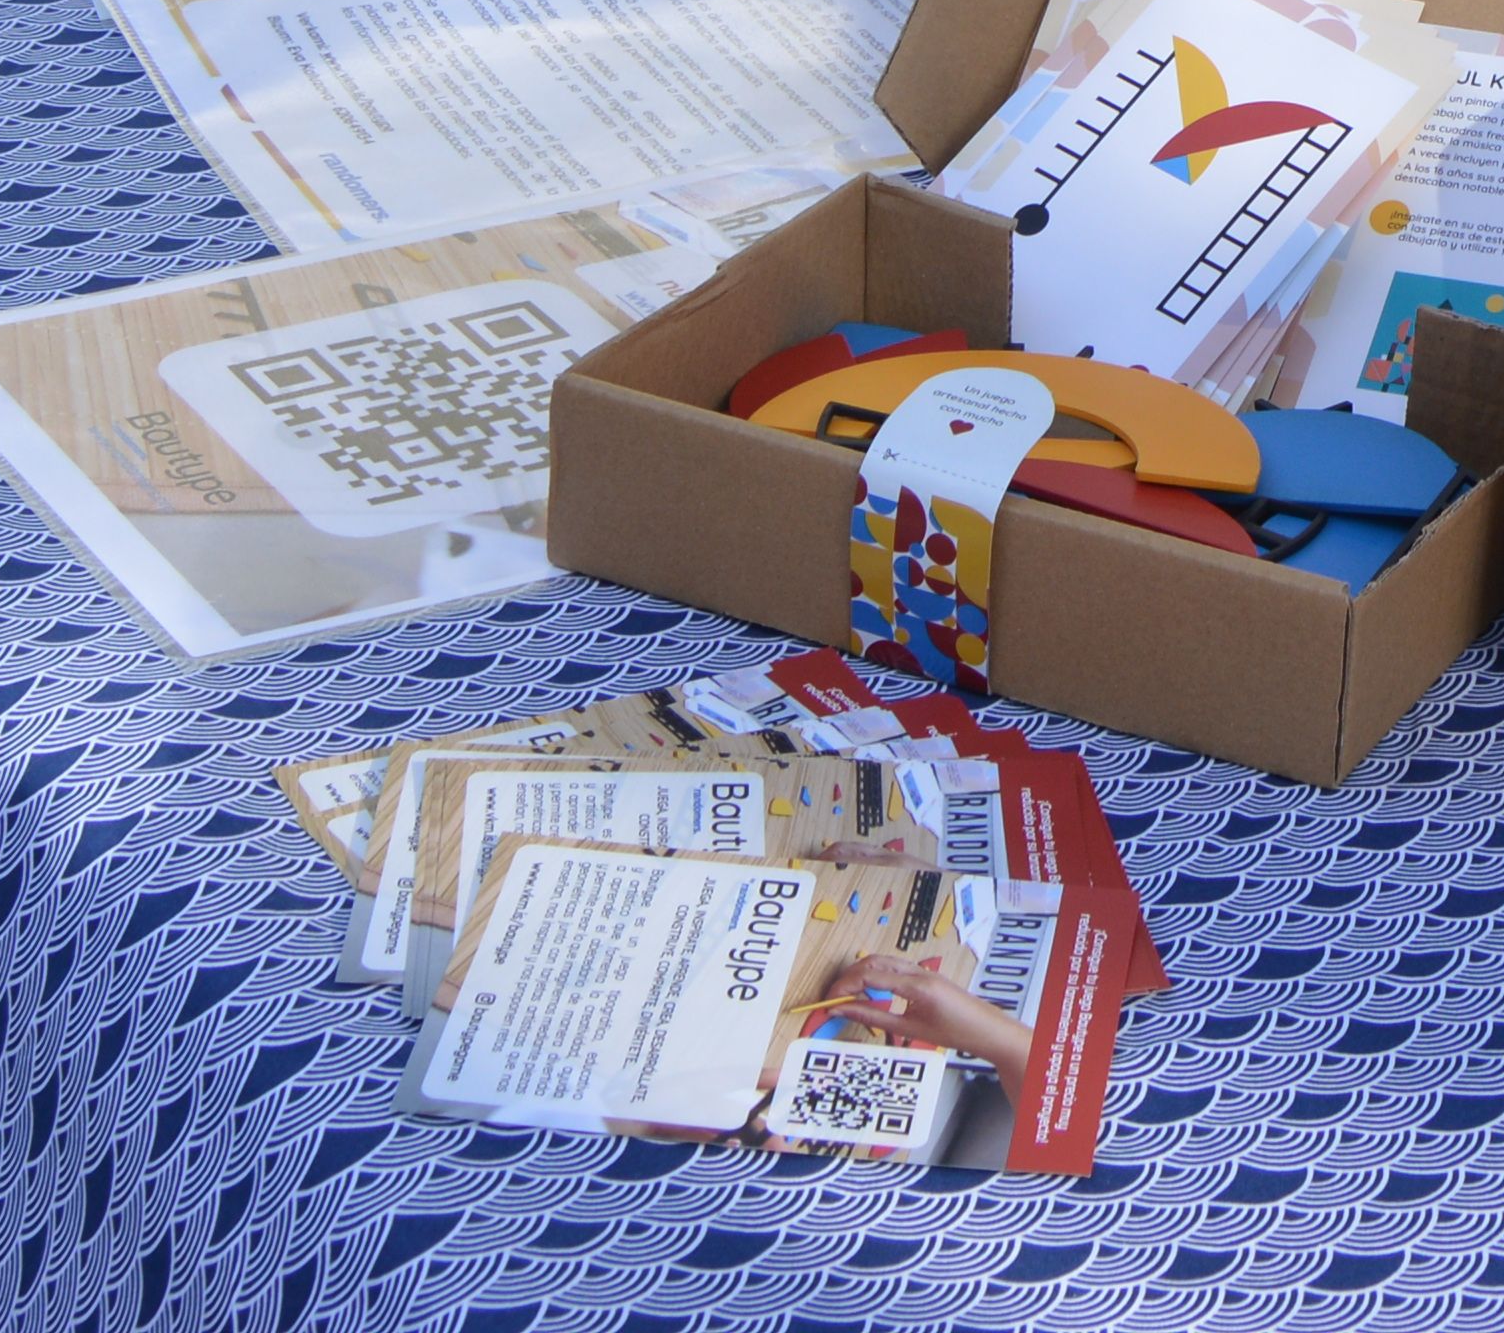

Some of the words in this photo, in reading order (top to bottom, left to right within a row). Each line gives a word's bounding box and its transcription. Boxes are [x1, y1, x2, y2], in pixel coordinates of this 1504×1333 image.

[1449, 95, 1462, 104] un
[1465, 96, 1498, 109] pintor
[1467, 113, 1498, 124] como
[1439, 125, 1483, 138] cuadros
[1449, 136, 1460, 147] la
[1462, 138, 1501, 153] música
[1420, 150, 1451, 161] veces
[1453, 150, 1499, 168] incluyen
[1395, 173, 1460, 190] destacaban
[1414, 164, 1430, 174] los
[1434, 166, 1443, 175] 16
[1447, 166, 1474, 180] años
[1476, 172, 1495, 182] sus
[319, 152, 390, 223] randomers.
[1387, 220, 1407, 231] con
[1411, 223, 1426, 233] las
[1429, 226, 1465, 240] piezas
[1468, 231, 1482, 241] de
[1444, 218, 1458, 227] en
[1462, 219, 1474, 230] su
[1477, 220, 1503, 235] obra
[1398, 233, 1447, 249] dibujarla
[1450, 242, 1458, 251] y
[1460, 242, 1497, 256] utilizar
[933, 389, 990, 410] artesanal
[991, 405, 1027, 421] hecho
[964, 385, 980, 395] Un
[981, 390, 1016, 405] juego
[939, 405, 961, 415] con
[963, 411, 1004, 427] mucho
[126, 411, 236, 505] Bautype
[946, 796, 995, 875] RANDO
[640, 869, 664, 907] Bautype
[696, 877, 715, 907] JUEGA,
[494, 862, 540, 964] www.vkm.is/bautype
[728, 883, 749, 930] randomers.
[610, 922, 625, 939] que
[633, 917, 645, 926] es
[660, 904, 689, 957] CONSTRUYE,
[681, 910, 705, 954] INSPÍRATE,
[628, 936, 637, 947] un
[727, 879, 798, 999] Bautype
[594, 946, 619, 983] fomenta
[613, 955, 630, 980] juego
[642, 960, 670, 1008] COMPARTE,
[666, 957, 689, 998] APRENDE,
[588, 989, 603, 998] la
[656, 1001, 675, 1026] CREA,
[447, 1008, 485, 1081] bautypegame
[572, 1052, 597, 1100] educativo
[631, 1029, 666, 1102] DESARRÓLLATE,
